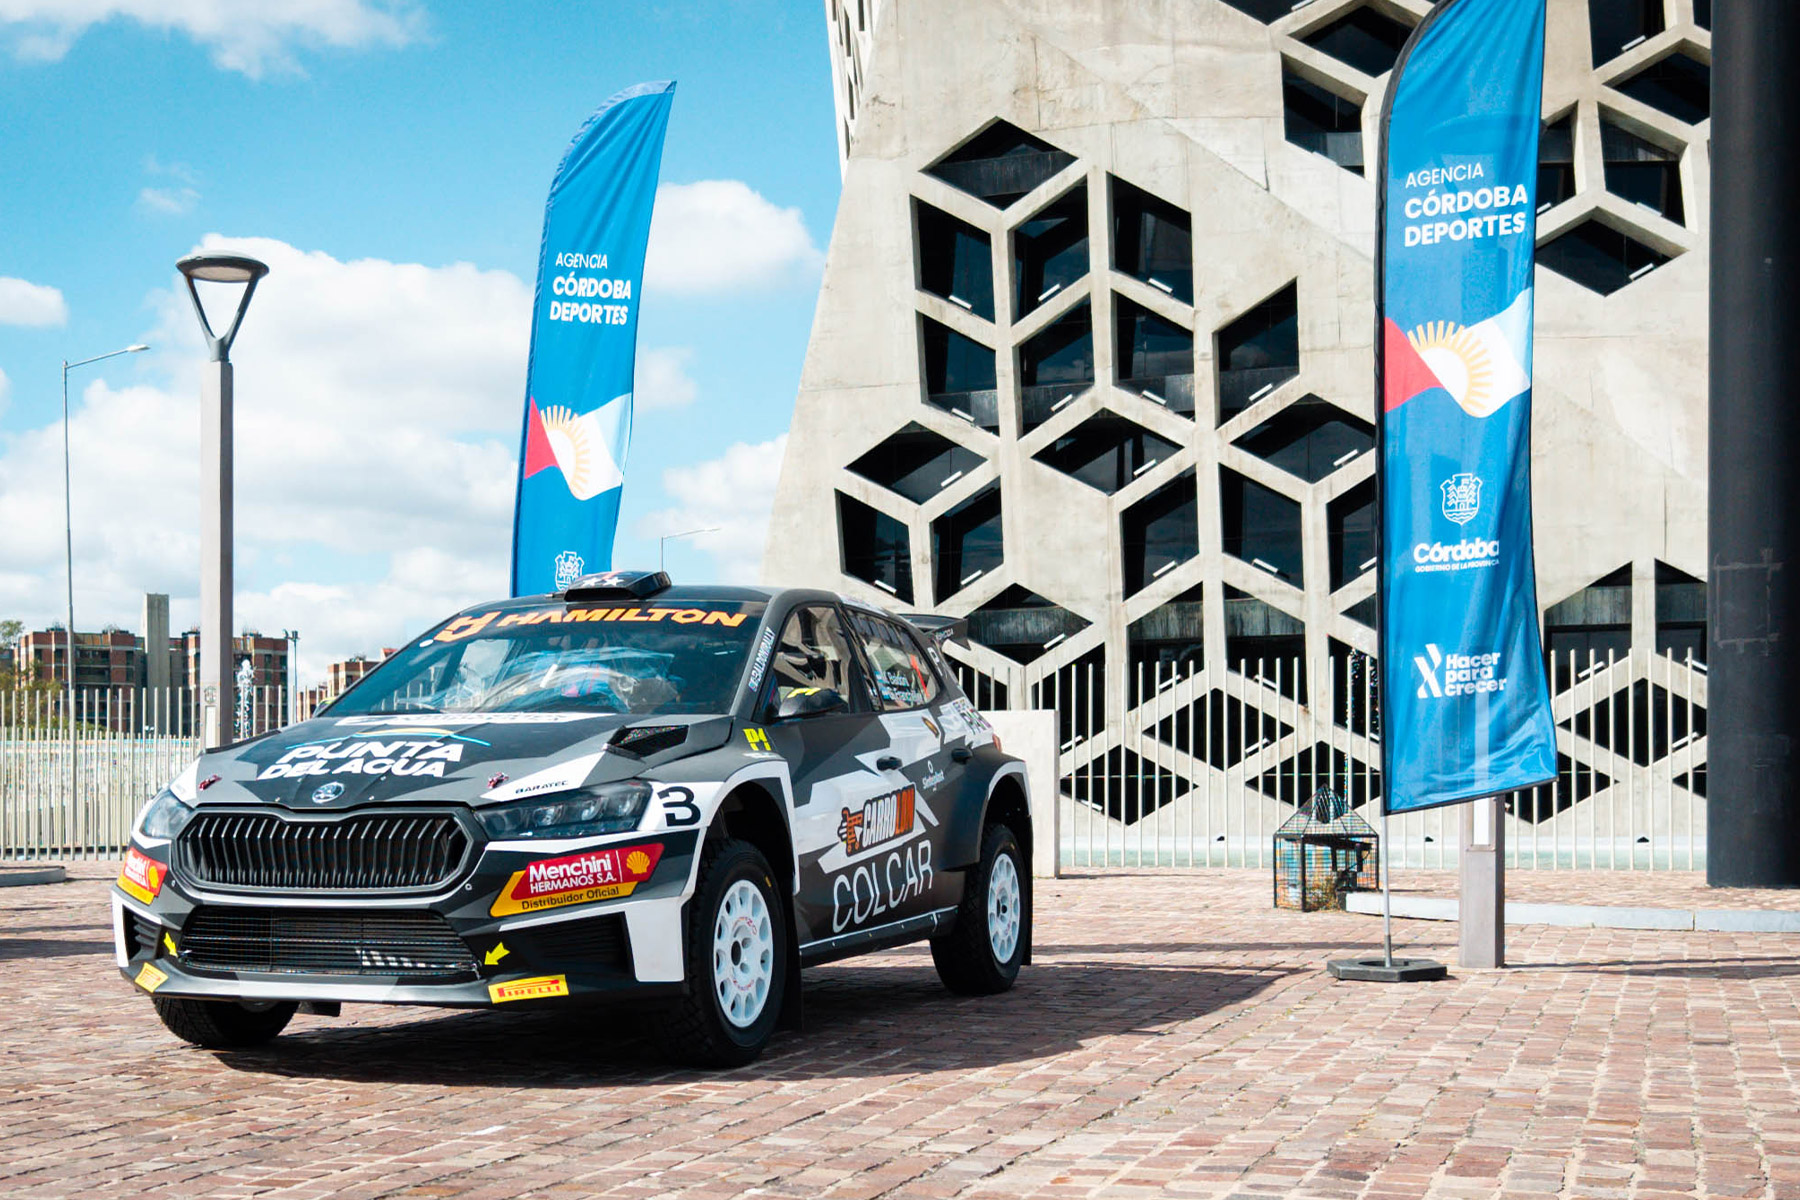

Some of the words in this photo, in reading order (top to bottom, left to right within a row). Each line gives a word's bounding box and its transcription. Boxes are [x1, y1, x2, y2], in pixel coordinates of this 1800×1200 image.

[1405, 162, 1484, 189] AGENCIA
[1404, 184, 1528, 219] CÓRDOBA
[1404, 212, 1526, 247] DEPORTES
[555, 252, 608, 269] AGENCIA
[553, 271, 631, 299] CÓRDOBA
[549, 301, 629, 325] DEPORTES
[1413, 537, 1499, 563] Córdoba
[1415, 563, 1450, 573] GOBIERNO
[1460, 561, 1468, 569] LA
[496, 608, 748, 627] HAMILTON
[1446, 652, 1501, 669] Hacer
[1445, 666, 1493, 684] para
[1444, 678, 1507, 696] crecer
[276, 741, 464, 764] PUNTA
[256, 760, 331, 780] DEL
[331, 758, 446, 777] AGUA
[529, 853, 612, 883] Menchini
[530, 874, 594, 894] HERMANOS
[597, 873, 617, 883] S.A.
[833, 839, 933, 933] COLCAR
[521, 892, 583, 910] Distribuidor
[586, 887, 619, 899] Oficial
